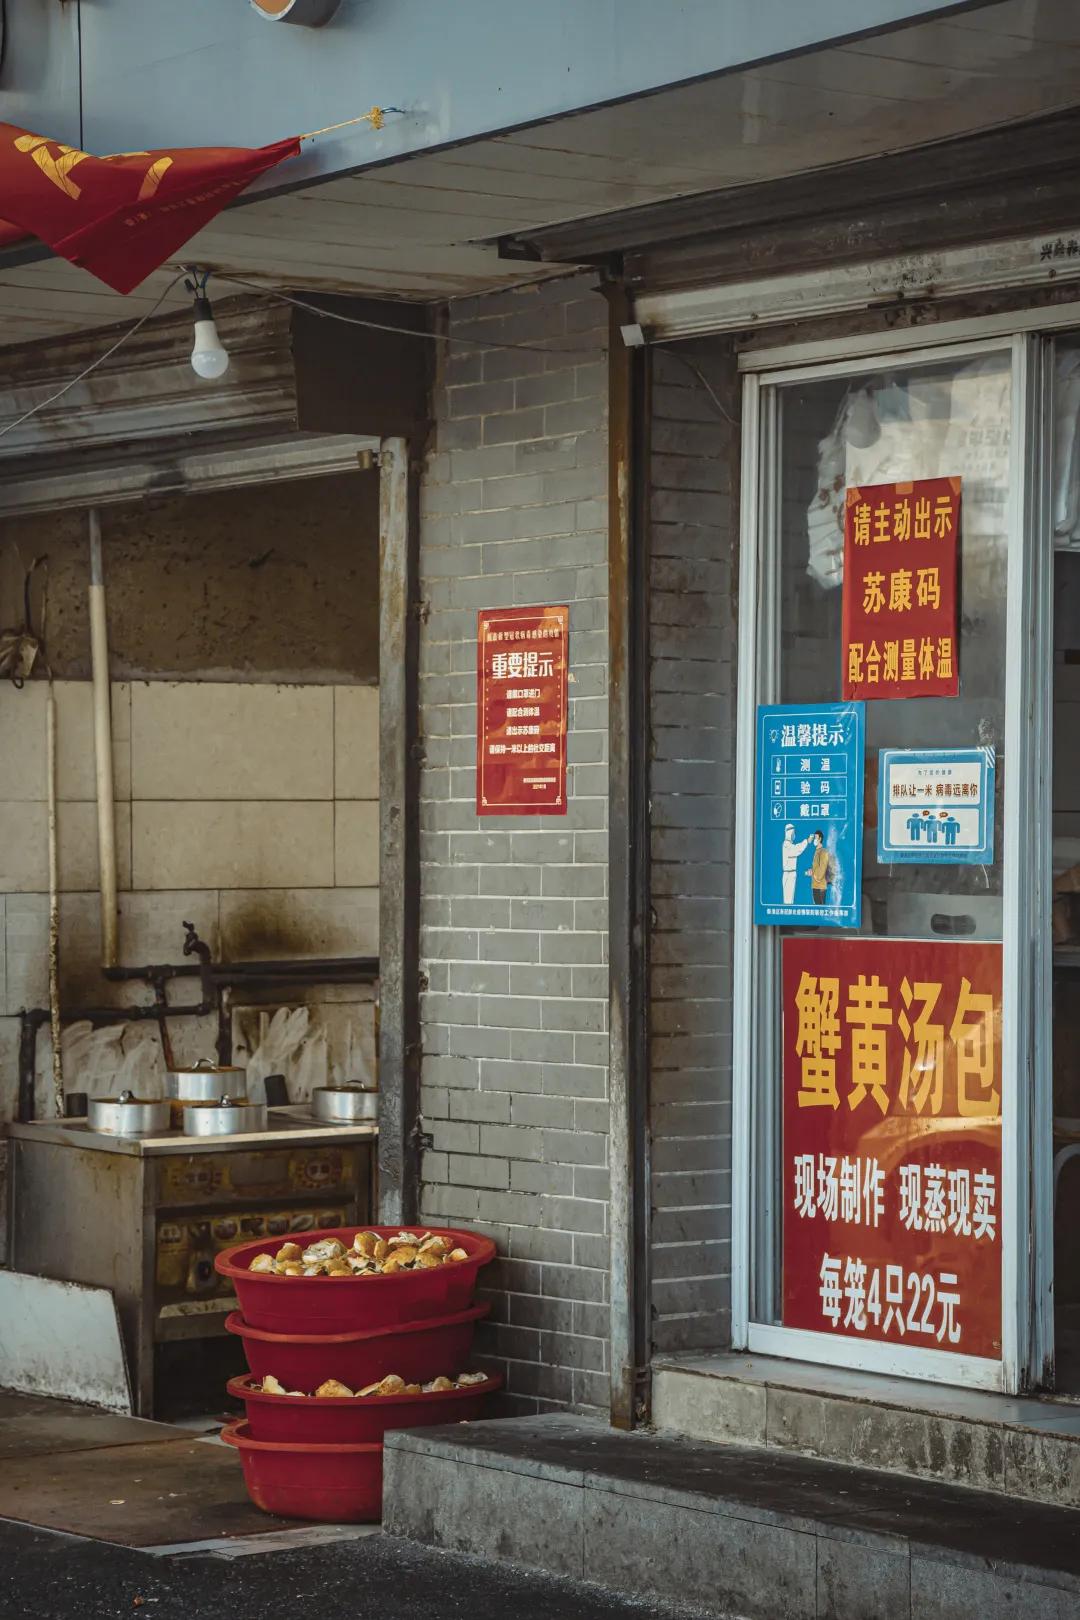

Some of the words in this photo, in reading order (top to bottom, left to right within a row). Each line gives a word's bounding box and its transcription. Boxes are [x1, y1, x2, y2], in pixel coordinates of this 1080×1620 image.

[853, 496, 953, 546] 请主动出示
[862, 567, 941, 615] 苏康码
[491, 651, 554, 680] 重要提示
[848, 637, 953, 683] 配合测量体温
[781, 723, 844, 748] 温馨提示
[800, 804, 830, 817] 戴口罩
[893, 784, 932, 798] 排队让一米
[936, 783, 978, 798] 病毒远离你
[795, 971, 1000, 1117] 蟹黄汤包
[794, 1152, 886, 1228] 现场制作
[899, 1162, 997, 1242] 现蒸现卖
[819, 1252, 961, 1344] 每笼4只22元
